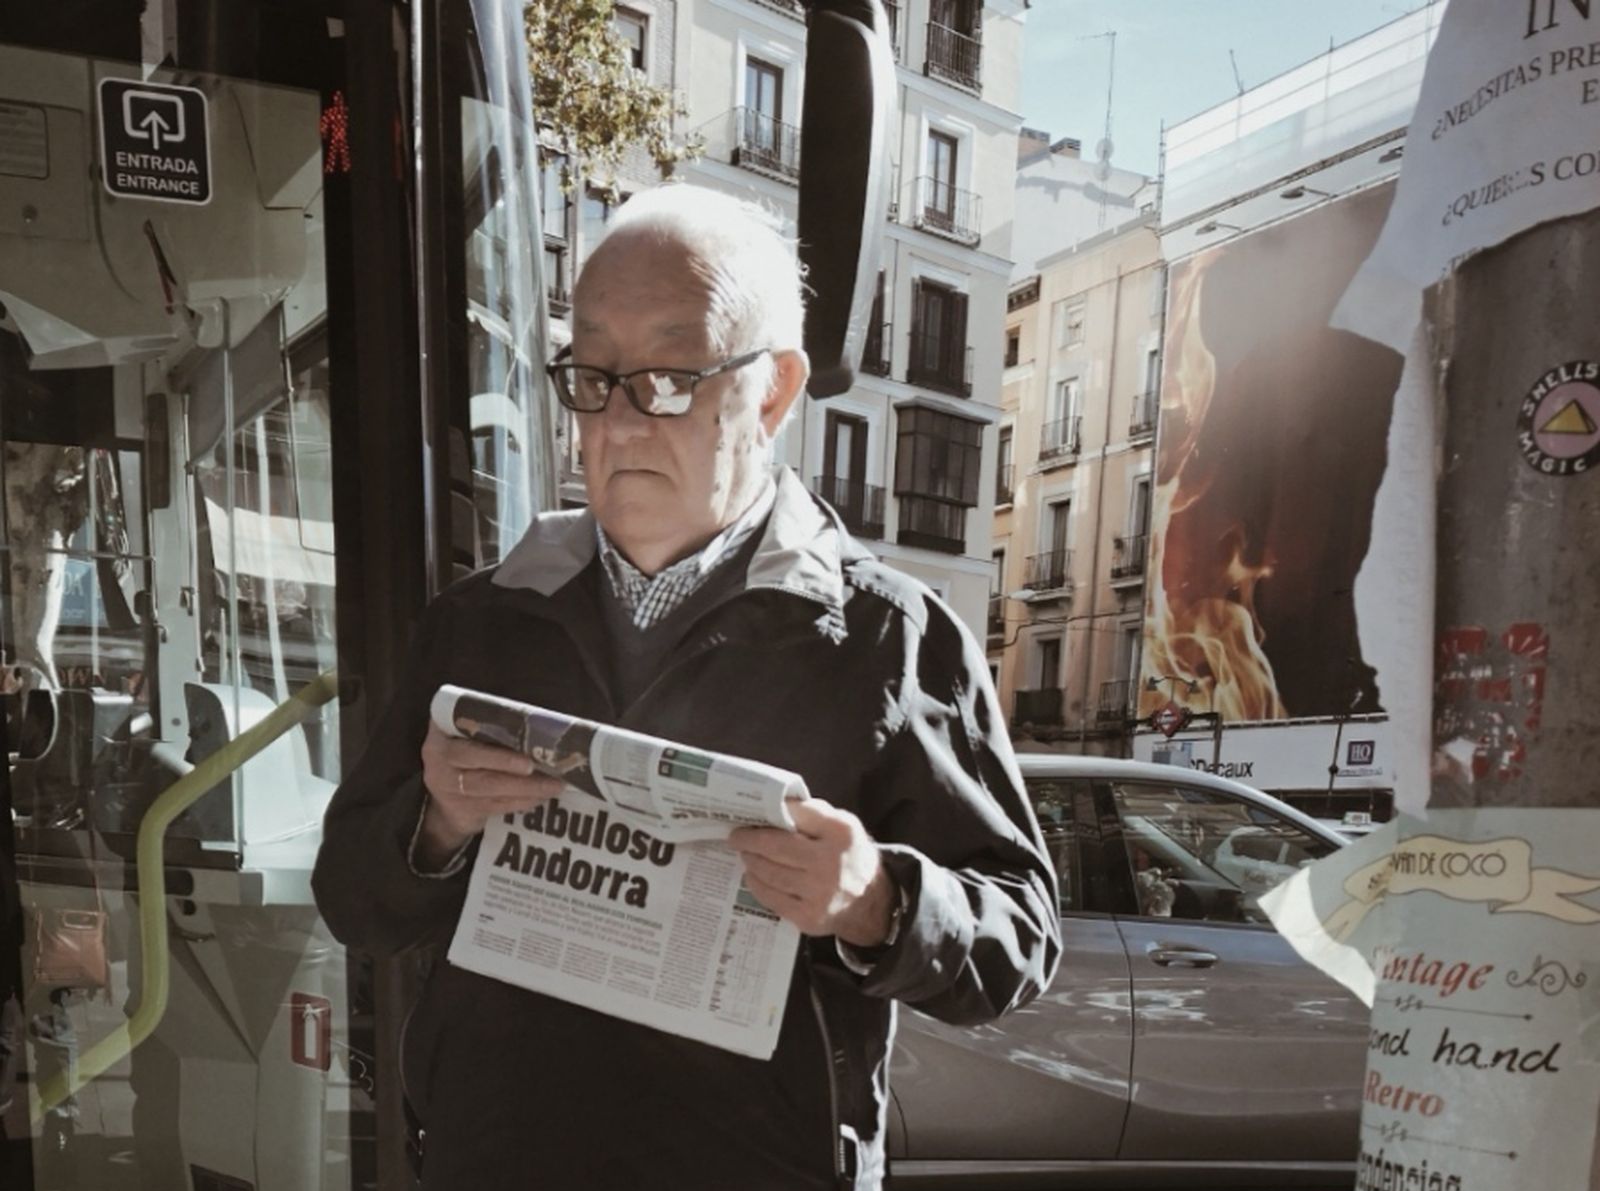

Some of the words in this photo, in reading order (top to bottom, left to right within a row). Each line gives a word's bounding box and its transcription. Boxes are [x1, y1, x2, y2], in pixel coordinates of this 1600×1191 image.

[1431, 57, 1543, 141] ¿NECESITAS
[115, 151, 199, 175] ENTRADA
[1554, 151, 1600, 182] CO
[116, 173, 200, 196] ENTRANCE
[1522, 362, 1599, 417] SMELLS
[1520, 431, 1587, 473] MAGIC
[1190, 757, 1254, 778] Decaux
[493, 831, 651, 909] Andorra
[1439, 850, 1507, 879] COCO
[1432, 1027, 1562, 1074] hand
[1362, 1069, 1446, 1119] Retro
